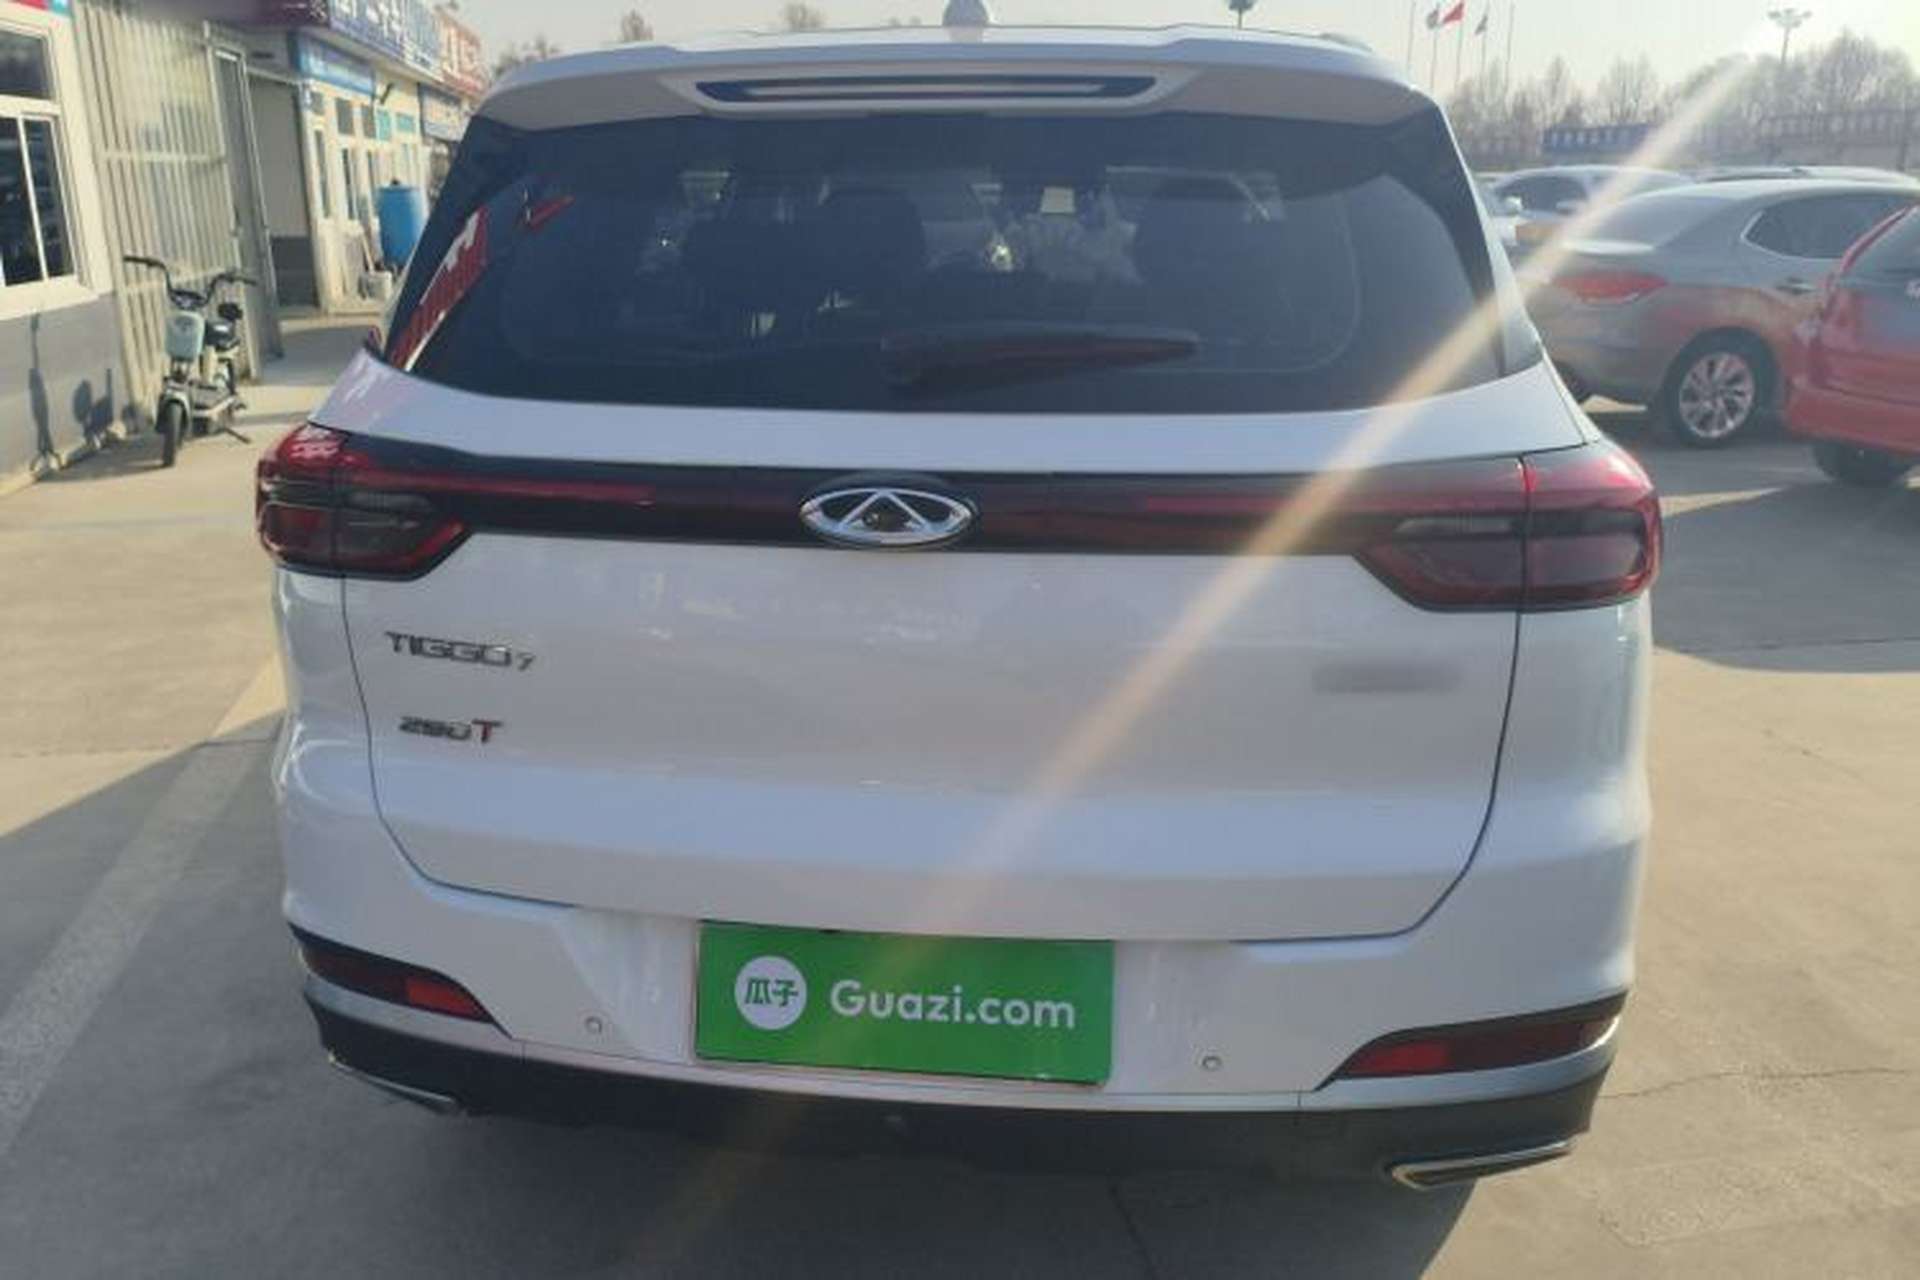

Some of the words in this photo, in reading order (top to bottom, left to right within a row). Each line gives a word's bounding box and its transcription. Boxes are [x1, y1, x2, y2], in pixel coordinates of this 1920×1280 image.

[385, 630, 512, 667] TIGGO
[515, 652, 536, 671] 7
[745, 977, 799, 1007] 瓜子
[830, 978, 1076, 1030] Guazi.com
